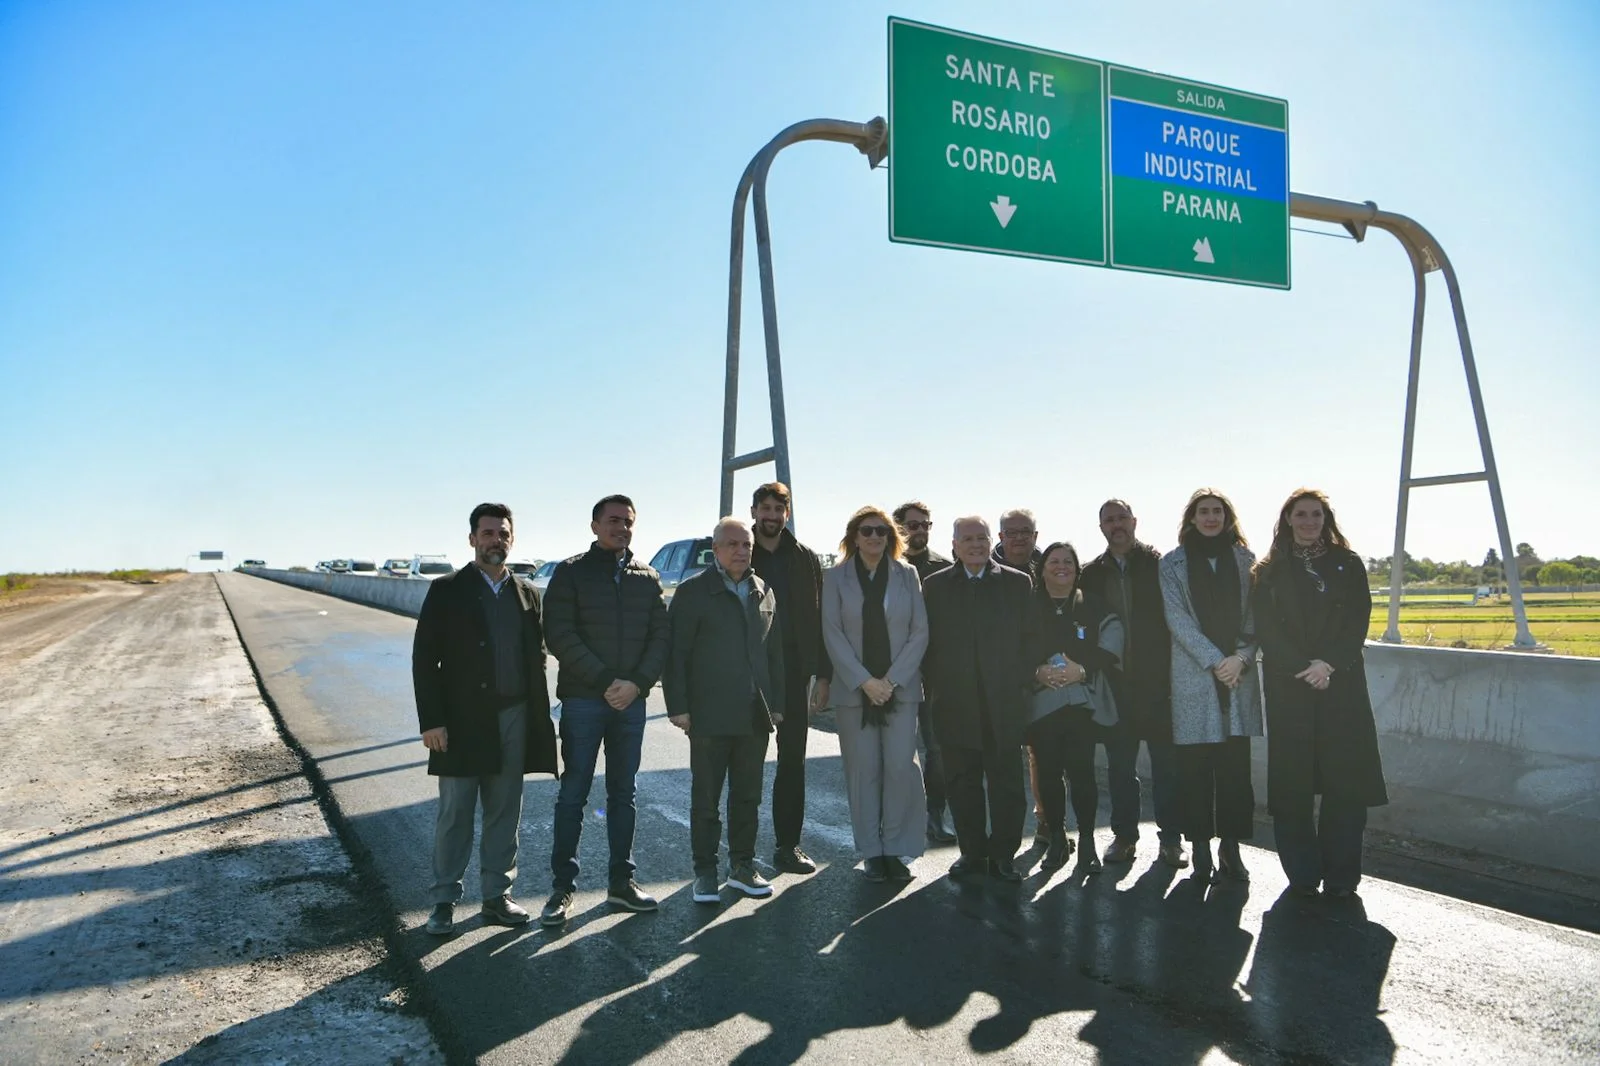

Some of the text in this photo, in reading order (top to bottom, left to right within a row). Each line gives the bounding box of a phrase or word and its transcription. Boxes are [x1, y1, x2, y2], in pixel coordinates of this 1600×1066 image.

[945, 54, 1056, 98] SANTA FE
[1176, 89, 1226, 111] SALIDA
[951, 100, 1051, 140] ROSARIO
[1162, 121, 1241, 157] PARQUE
[945, 144, 1057, 183] CORDOBA
[1144, 152, 1258, 192] INDUSTRIAL
[1162, 191, 1242, 224] PARANA
